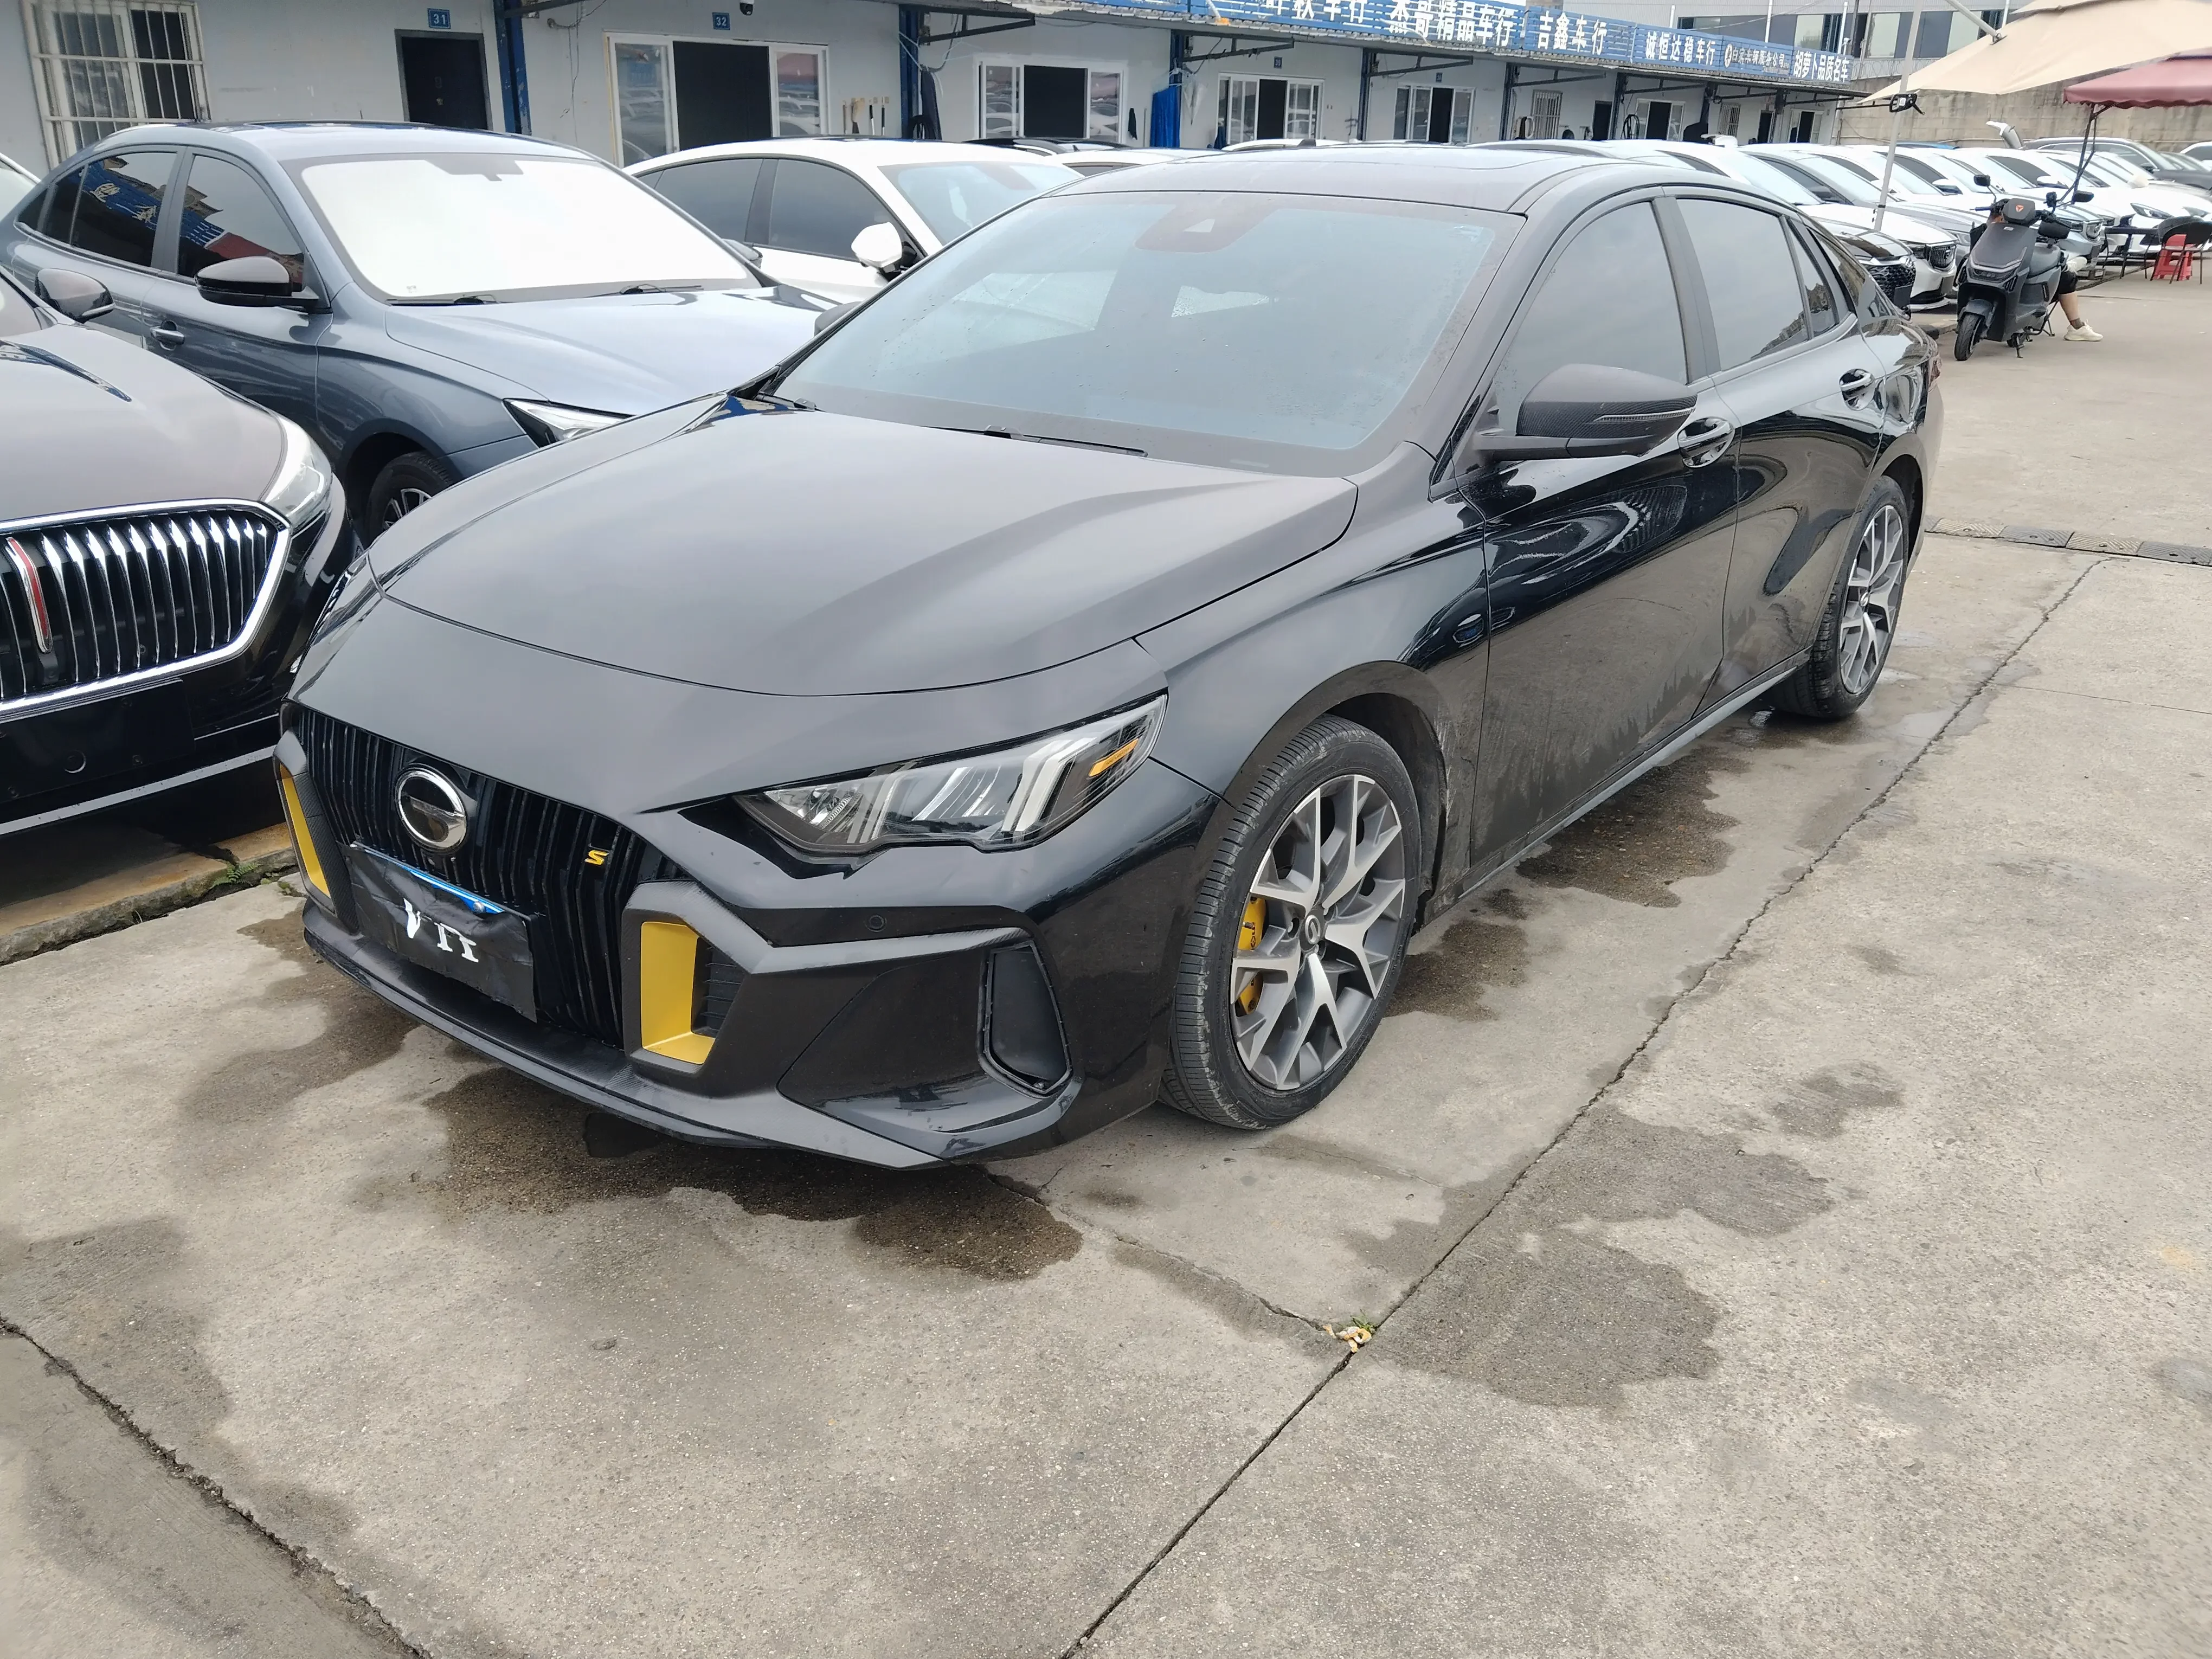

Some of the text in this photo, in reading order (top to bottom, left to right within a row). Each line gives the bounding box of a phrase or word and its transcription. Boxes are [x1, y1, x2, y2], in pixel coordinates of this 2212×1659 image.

[434, 14, 446, 24] 31
[716, 16, 727, 26] 32
[1538, 10, 1607, 55] 吉鑫车行
[1793, 50, 1849, 83] 胡萝卜品质名车
[584, 850, 609, 865] S
